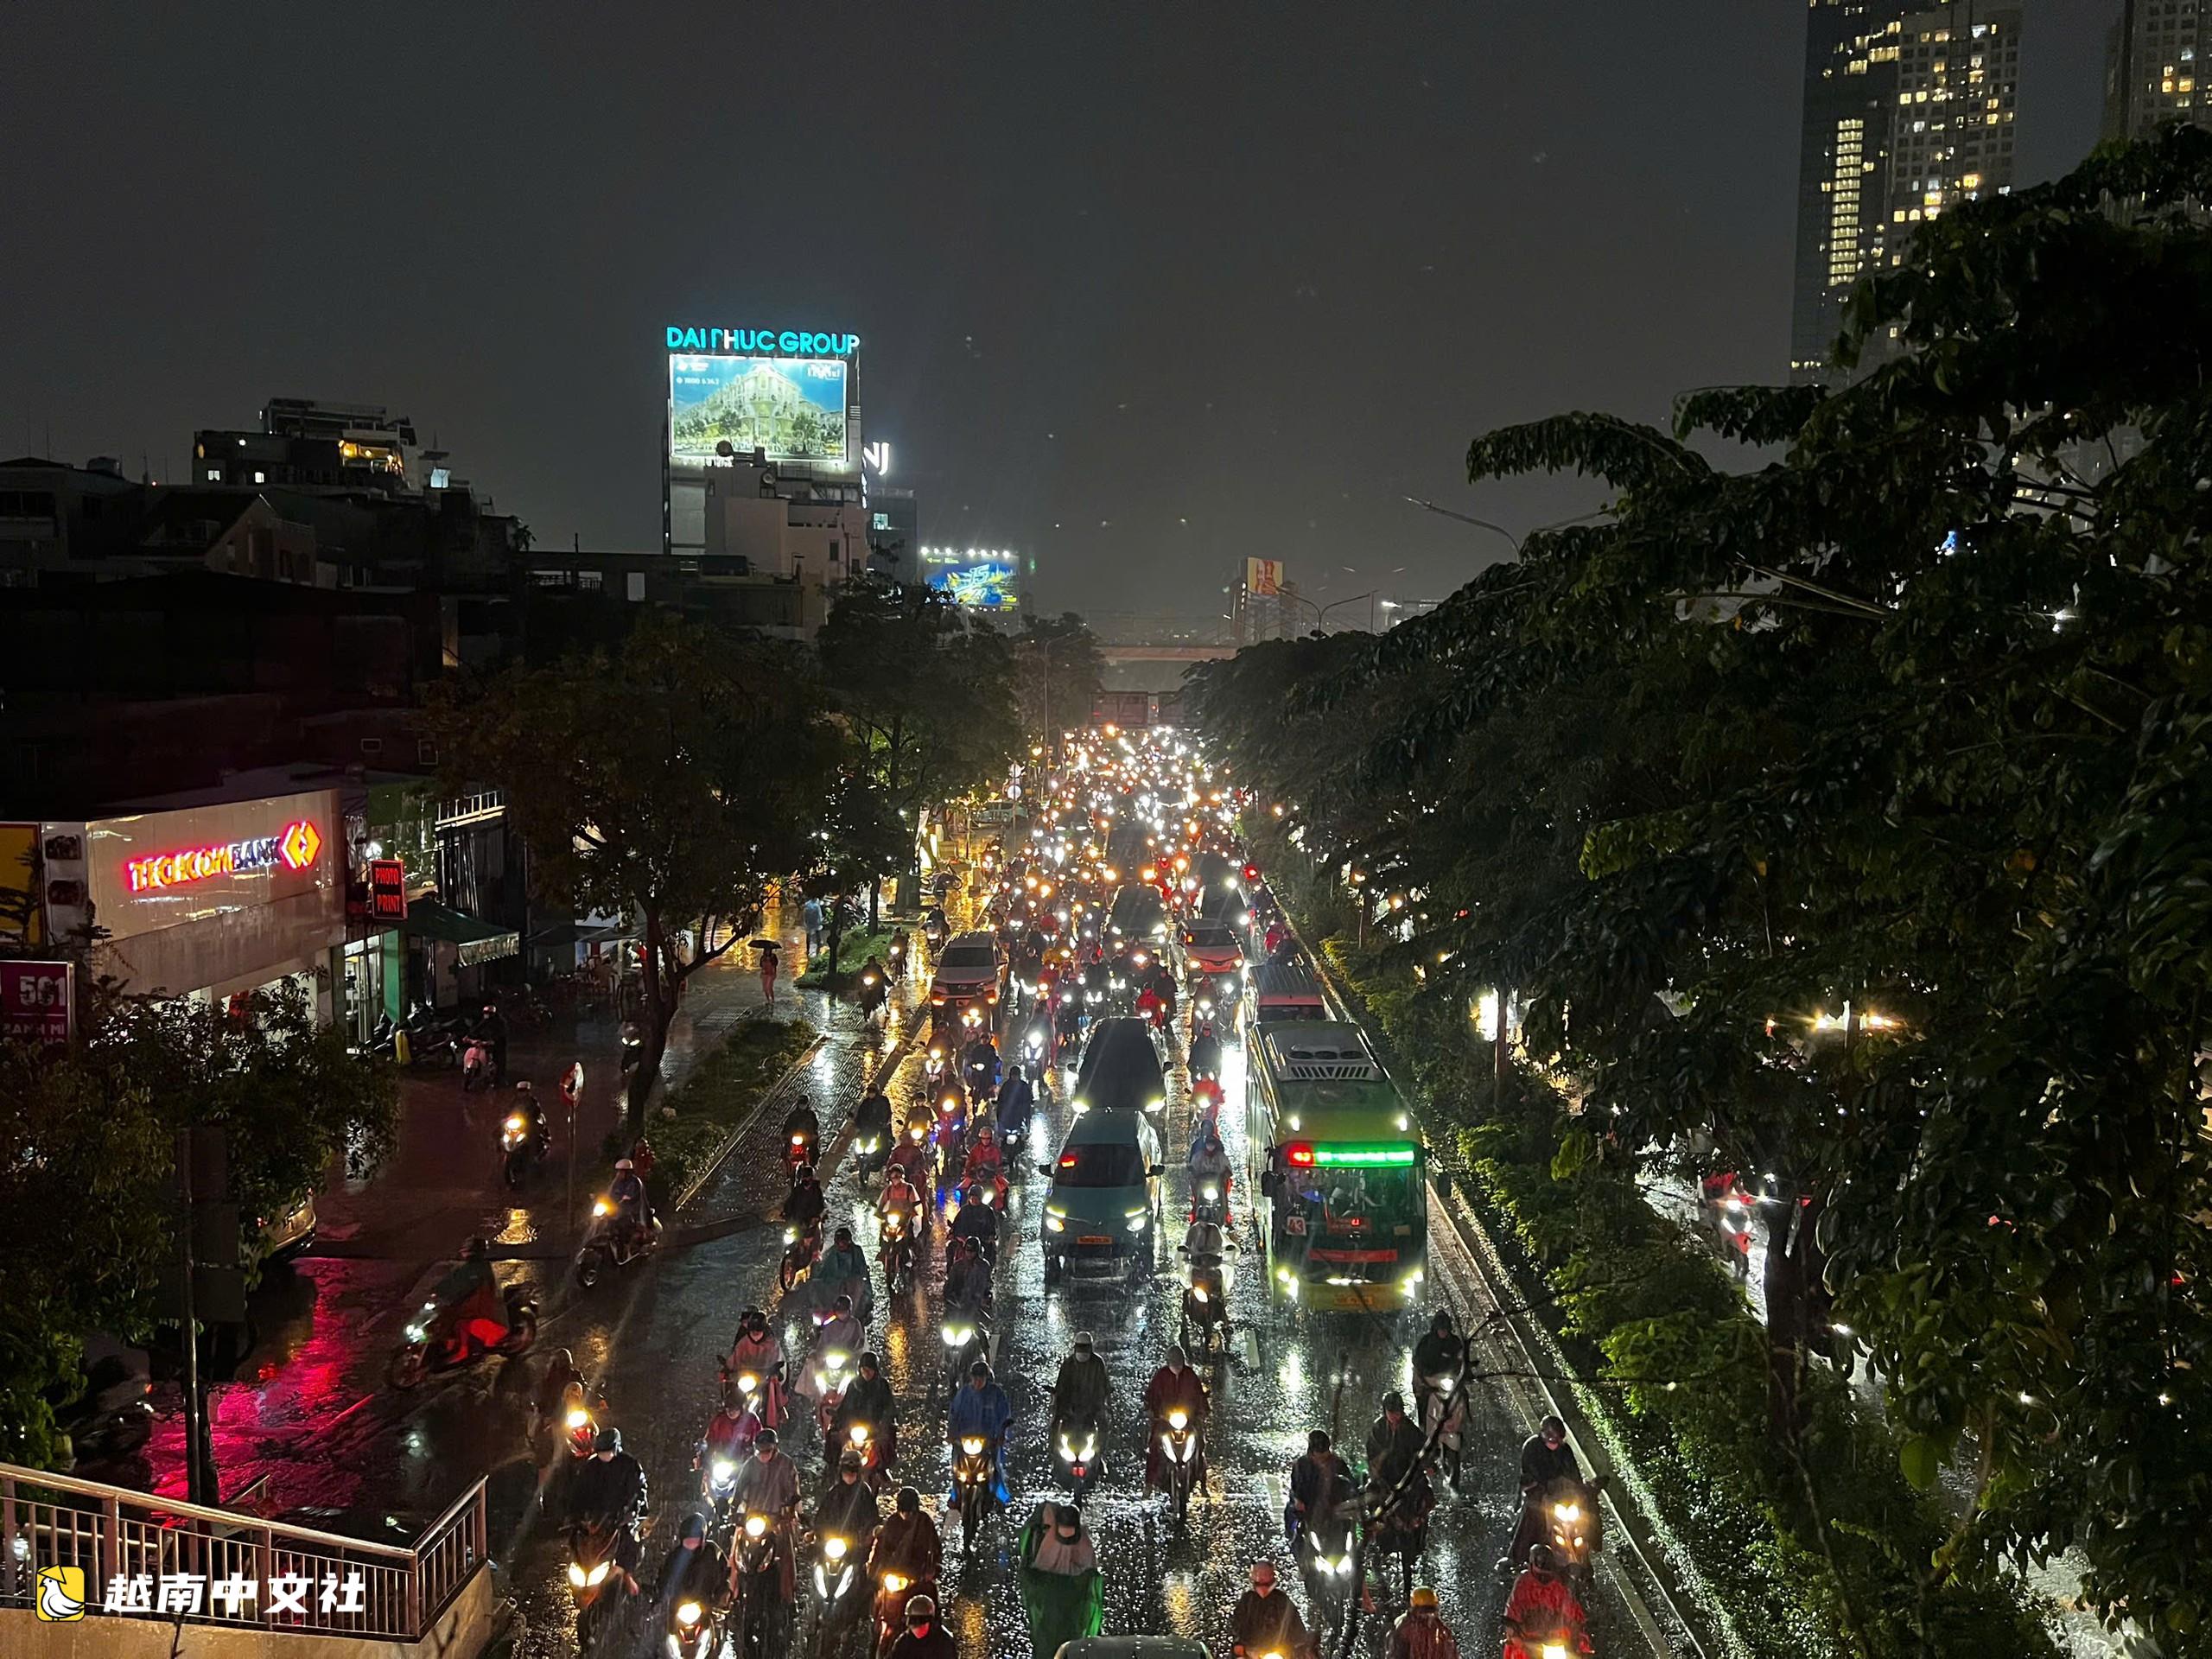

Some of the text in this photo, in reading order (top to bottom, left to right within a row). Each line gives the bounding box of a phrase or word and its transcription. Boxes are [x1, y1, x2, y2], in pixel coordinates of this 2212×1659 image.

[666, 327, 705, 347] DAI
[779, 332, 860, 354] GROUP
[130, 837, 281, 892] TECHCOMBANK
[375, 868, 399, 885] PHOTO
[377, 894, 400, 913] PRINT
